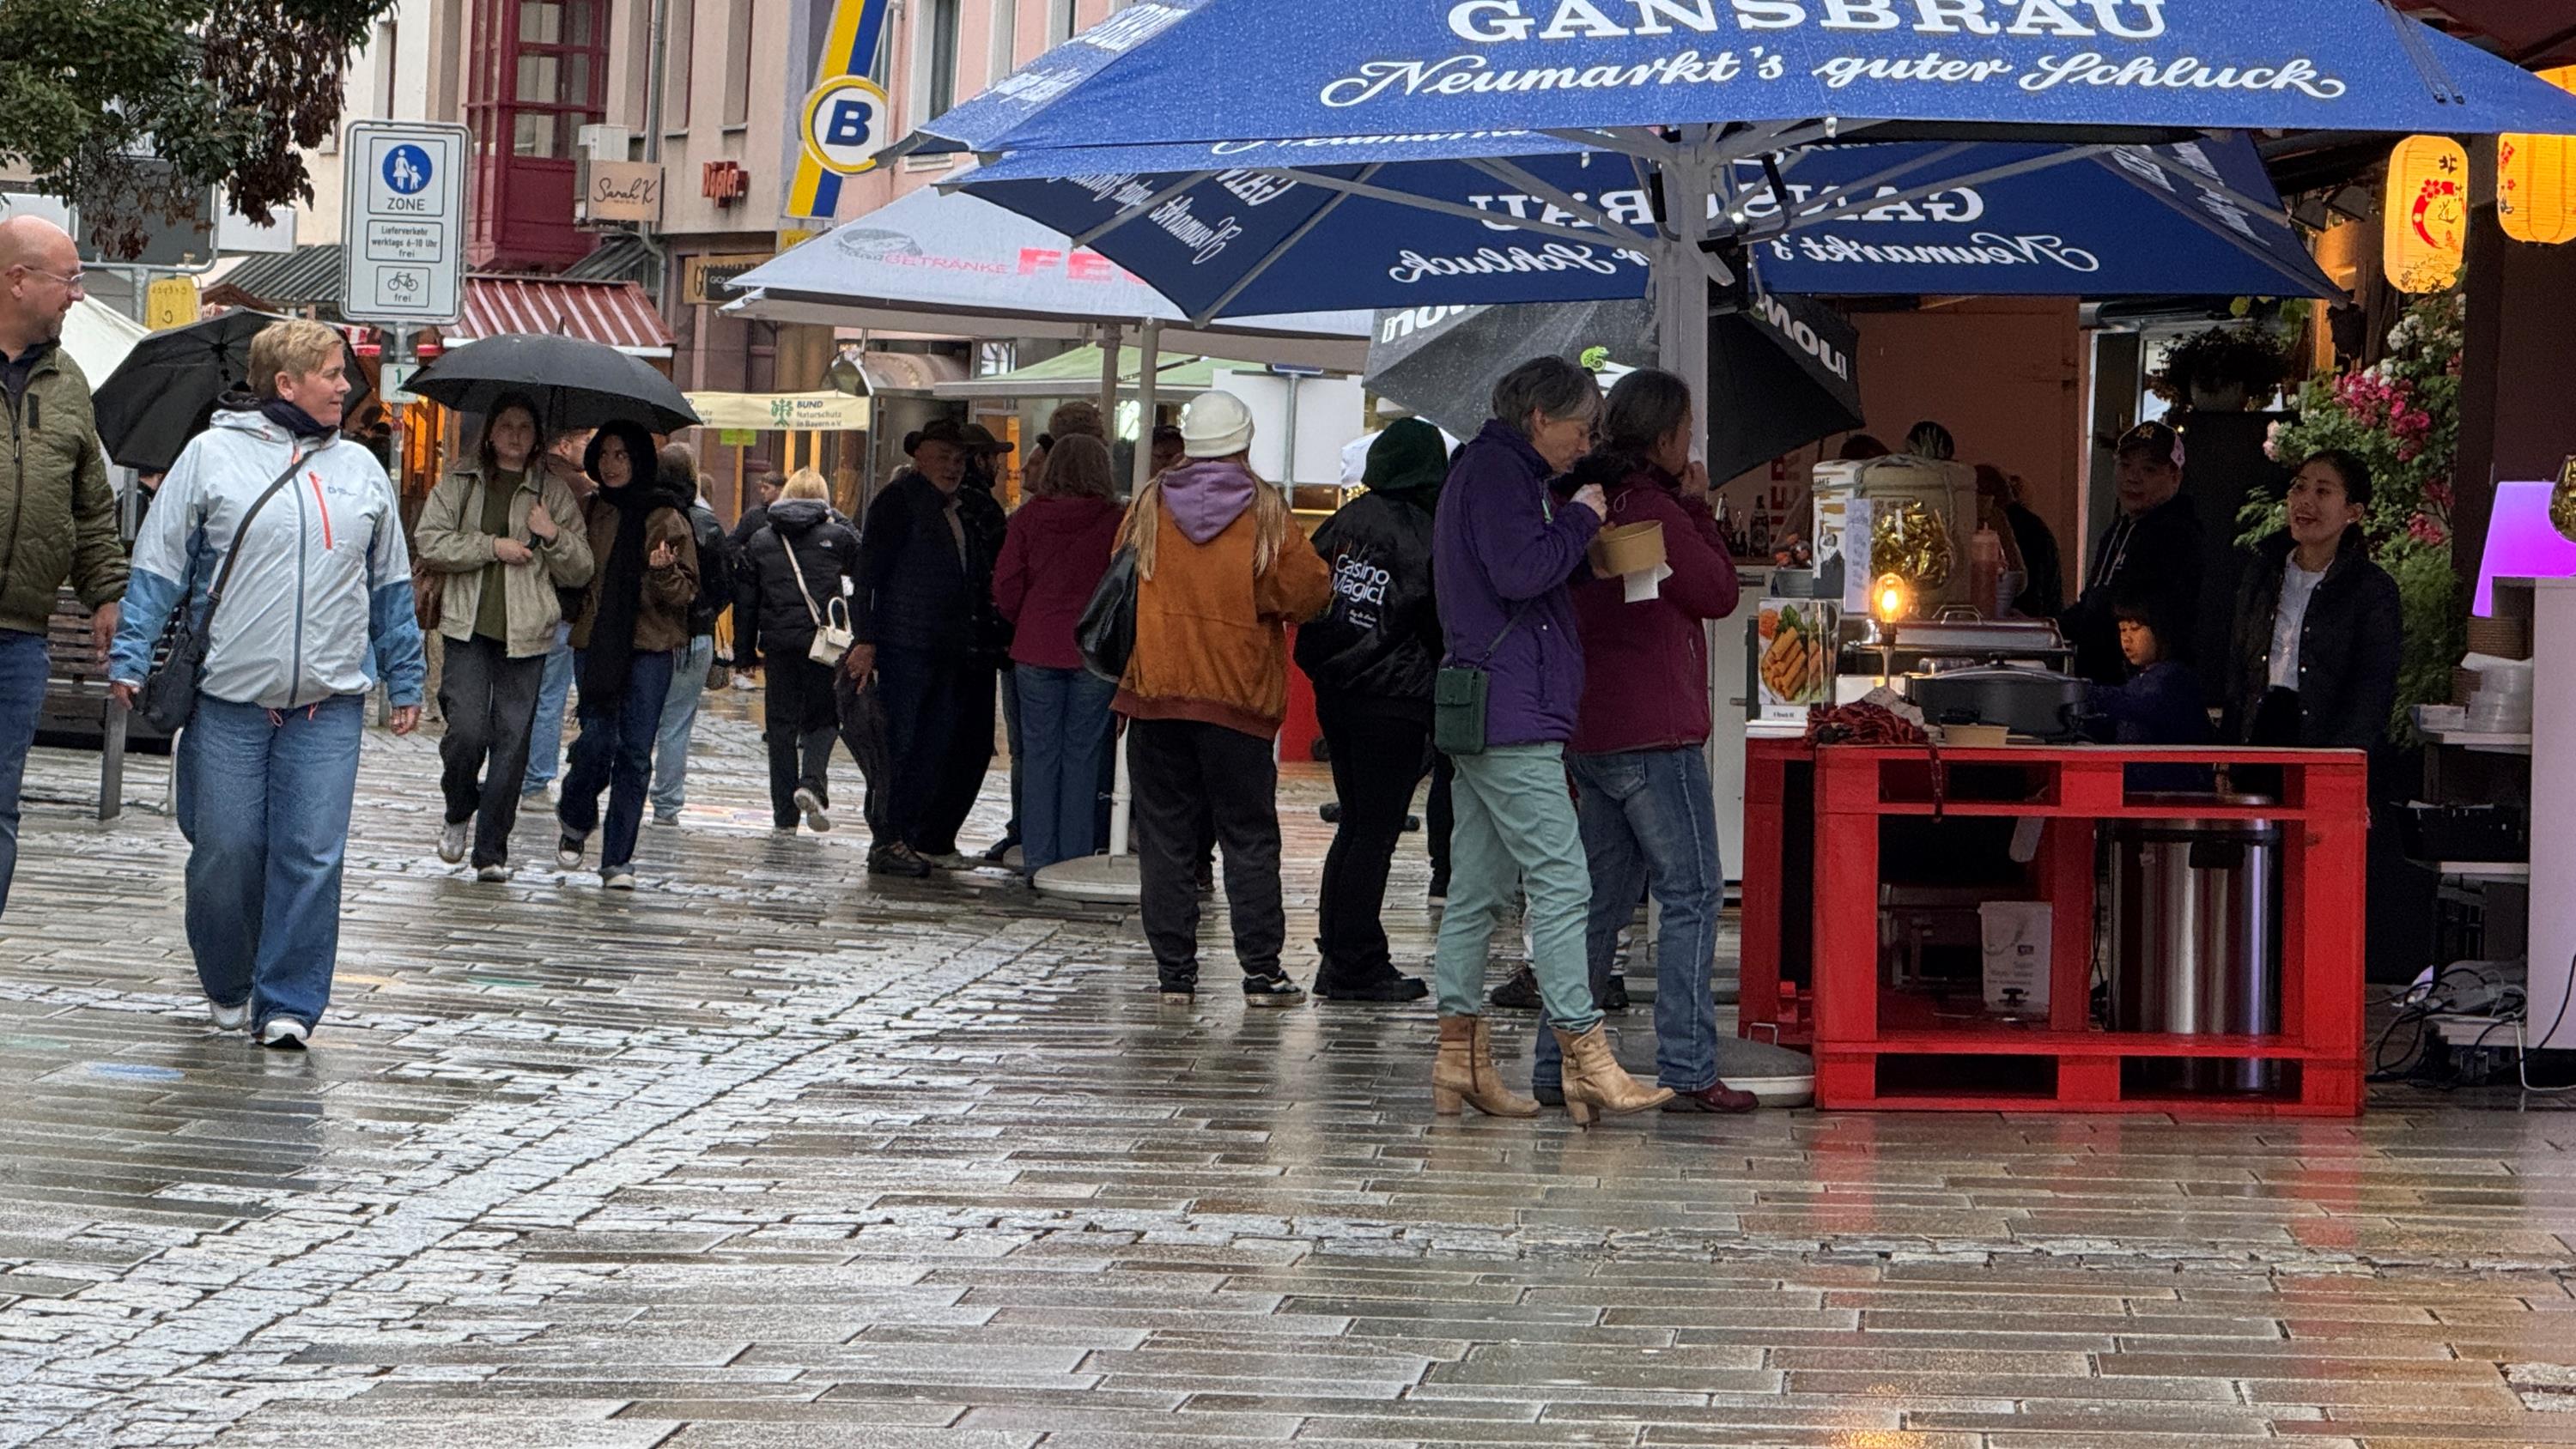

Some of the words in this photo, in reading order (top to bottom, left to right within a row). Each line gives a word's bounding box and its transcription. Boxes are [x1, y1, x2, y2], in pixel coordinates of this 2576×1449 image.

[1320, 45, 1785, 108] Neumarkt's
[1811, 52, 2014, 88] guter
[2019, 52, 2347, 99] Schluck
[824, 99, 872, 147] B
[386, 197, 426, 211] ZONE
[380, 226, 428, 236] Lieferverkehr
[371, 239, 404, 248] werktags
[425, 239, 438, 248] Uhr
[398, 249, 416, 258] frei
[884, 252, 1009, 275] GETRÄNKE
[394, 294, 412, 302] frei
[395, 367, 402, 384] 1
[797, 400, 824, 409] BUND
[797, 410, 842, 420] Naturschutz
[1335, 554, 1390, 585] Casino
[1330, 573, 1386, 606] Magic!
